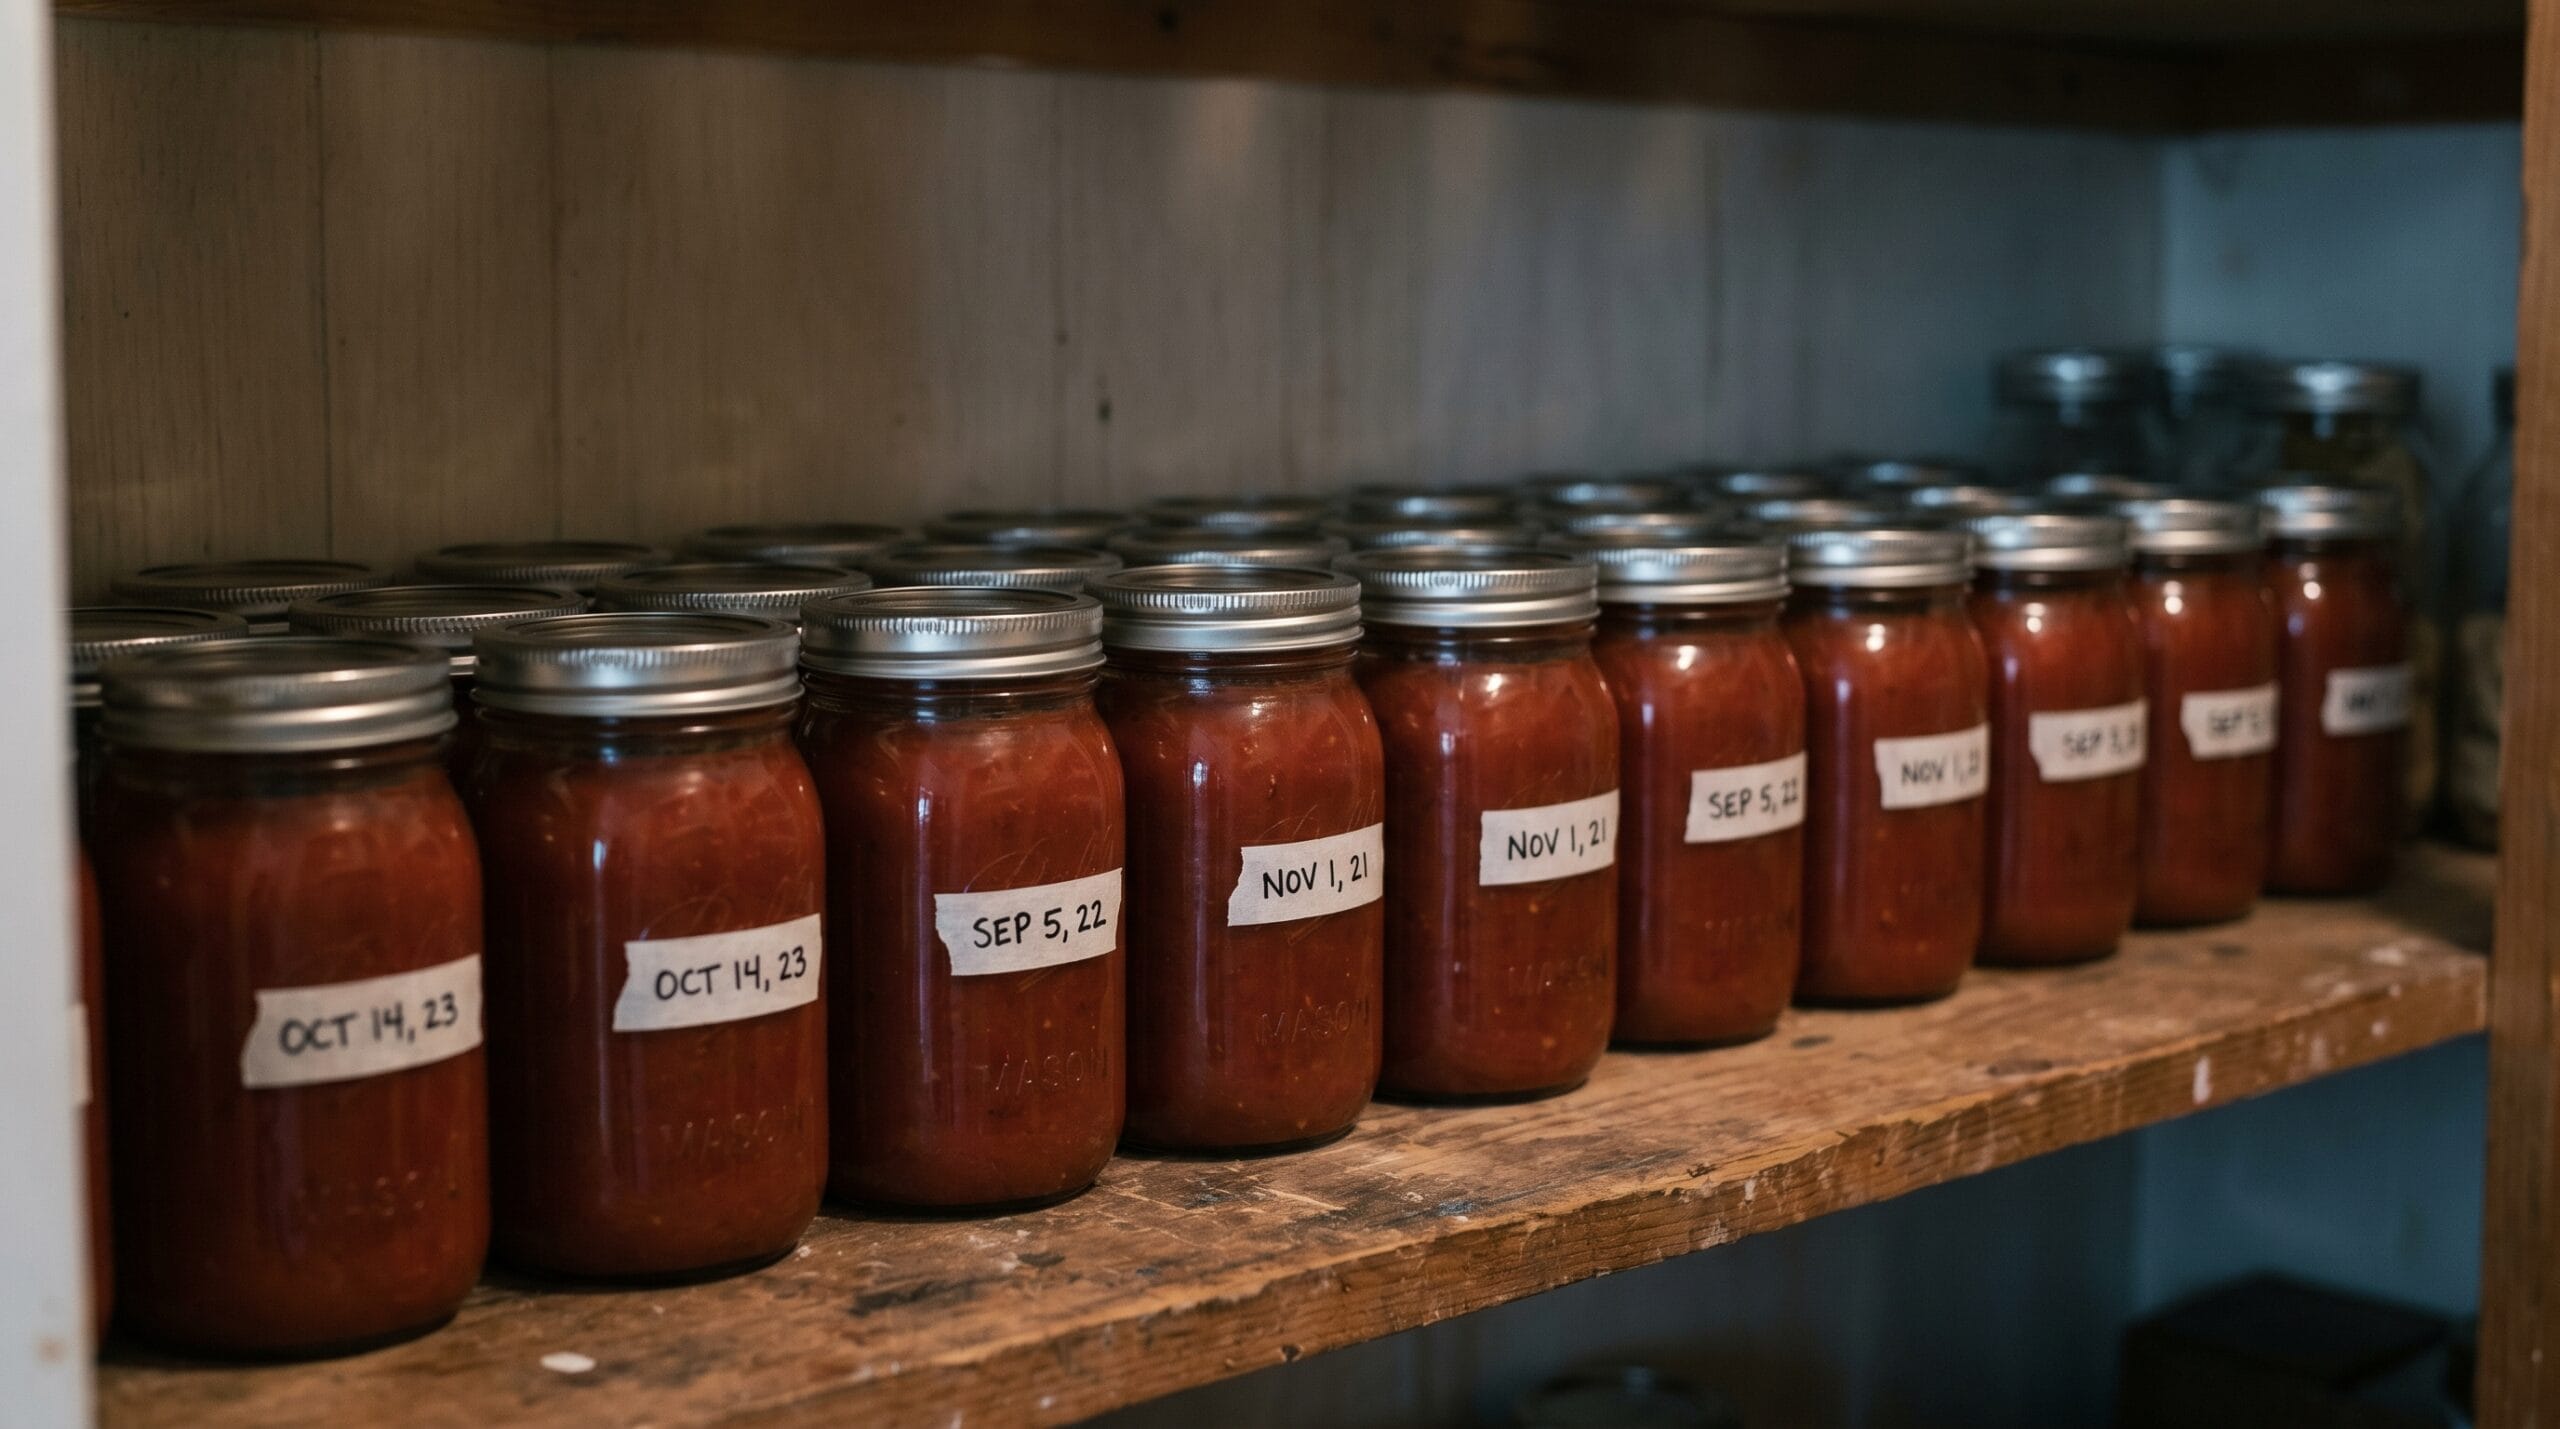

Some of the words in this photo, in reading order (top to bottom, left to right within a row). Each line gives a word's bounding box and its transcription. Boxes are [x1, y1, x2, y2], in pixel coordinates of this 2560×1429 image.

[1901, 756, 1947, 786] NOV
[1708, 786, 1753, 819] SEP
[1760, 783, 1777, 815] 5,
[1508, 827, 1559, 861] NOV
[1571, 823, 1584, 857] 1,
[1589, 816, 1607, 846] 21
[1263, 862, 1317, 899] NOV
[1329, 859, 1343, 893] 1,
[1350, 851, 1368, 882] 21
[973, 911, 1031, 949] SEP
[1043, 907, 1069, 944] 5,
[1076, 900, 1107, 933] 22
[655, 963, 721, 1001] OCT
[734, 953, 770, 993] 14,
[778, 945, 807, 981] 23
[278, 1013, 358, 1057] OCT
[371, 1002, 416, 1044] 14,
[422, 991, 459, 1031] 23
